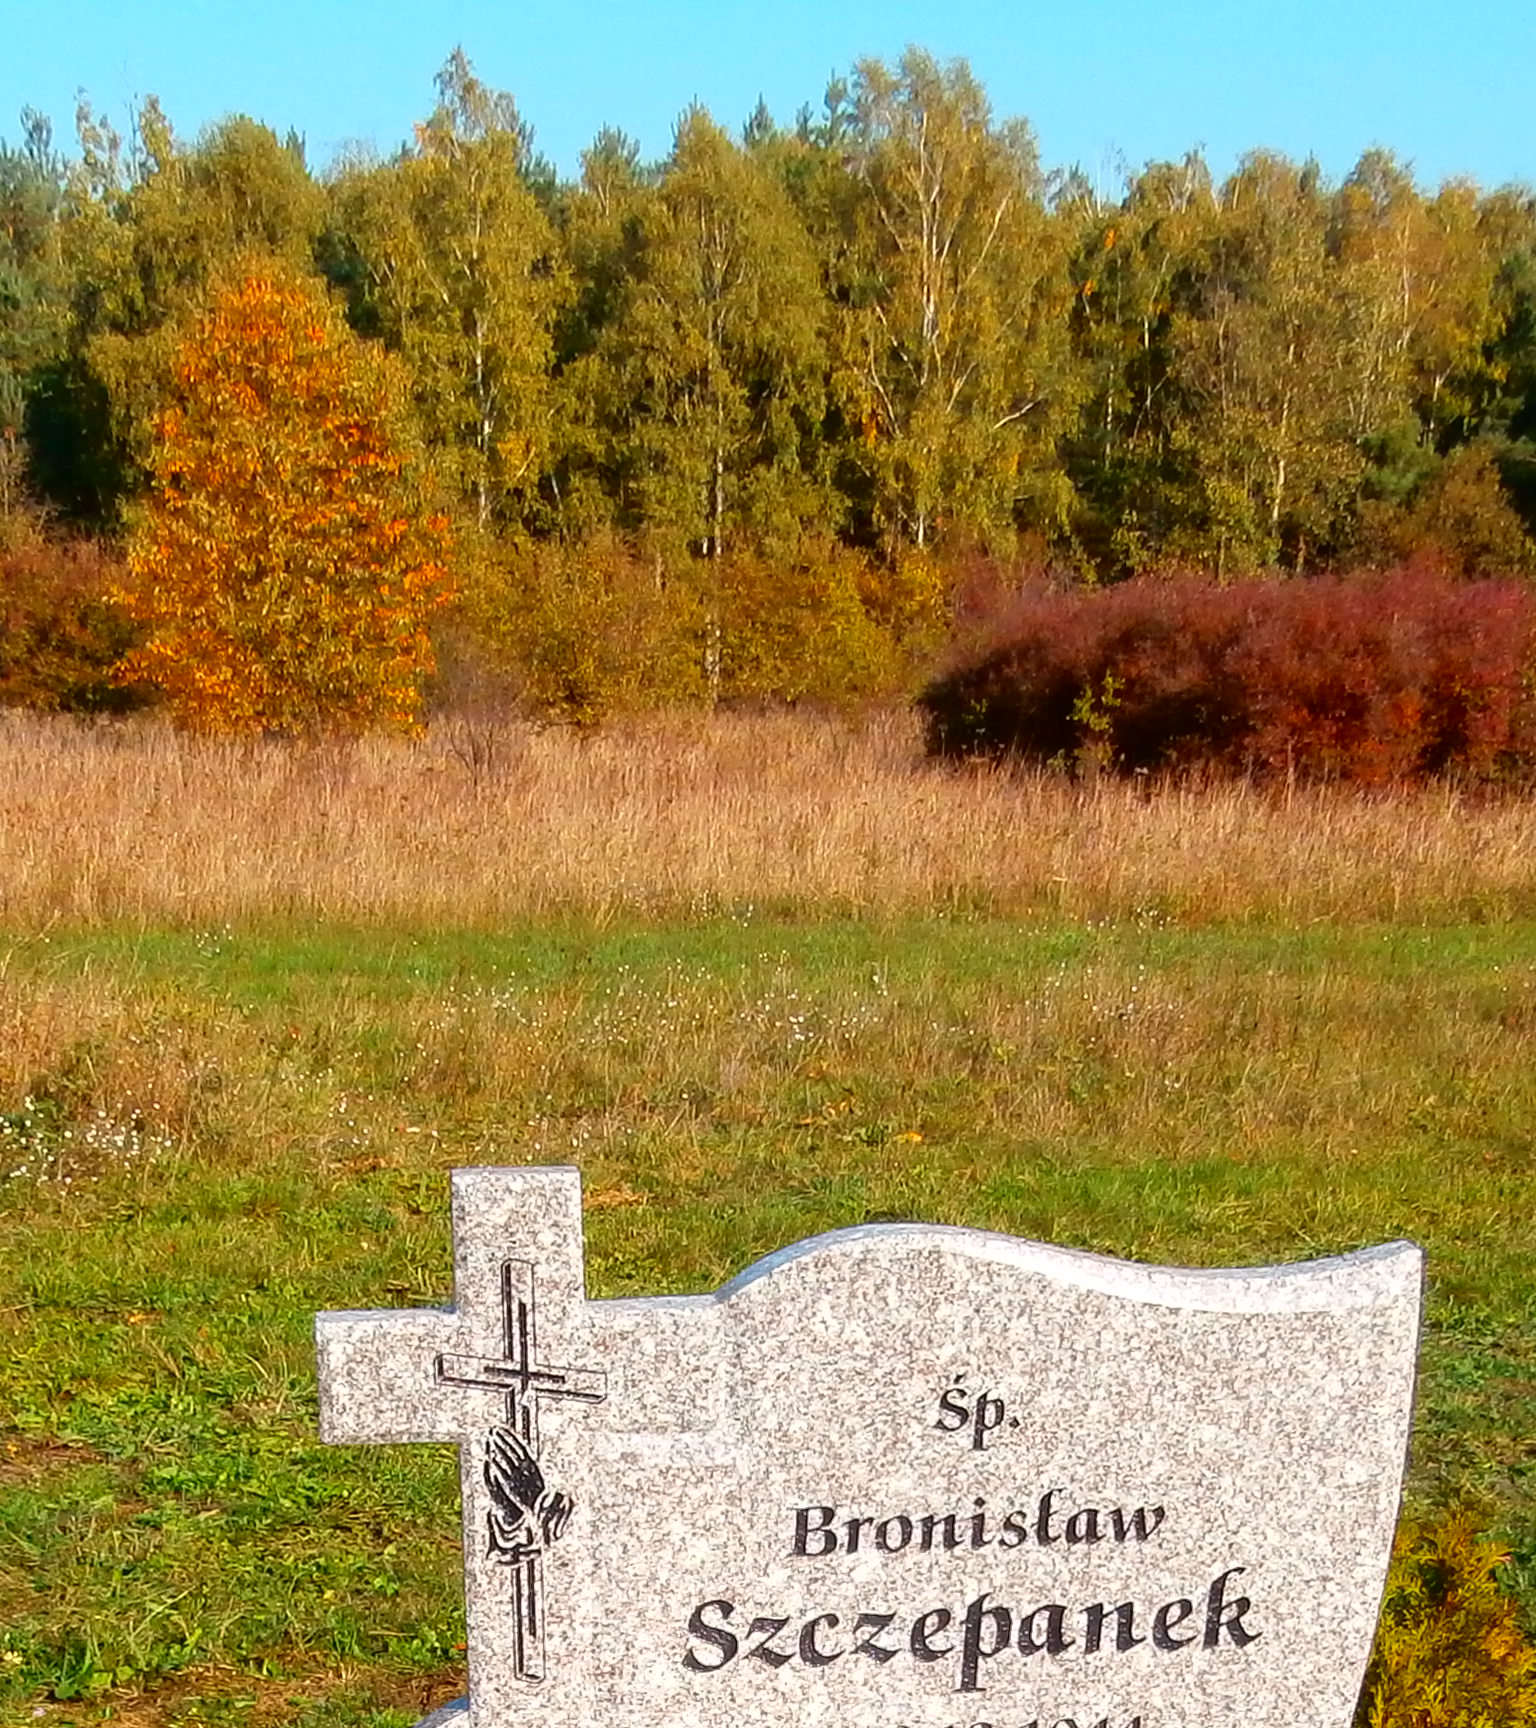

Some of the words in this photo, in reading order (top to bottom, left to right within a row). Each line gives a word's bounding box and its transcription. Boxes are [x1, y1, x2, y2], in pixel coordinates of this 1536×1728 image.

[932, 1373, 1022, 1452] Śp.
[786, 1487, 1166, 1559] Bronisław
[681, 1566, 1263, 1694] Szczepanek
